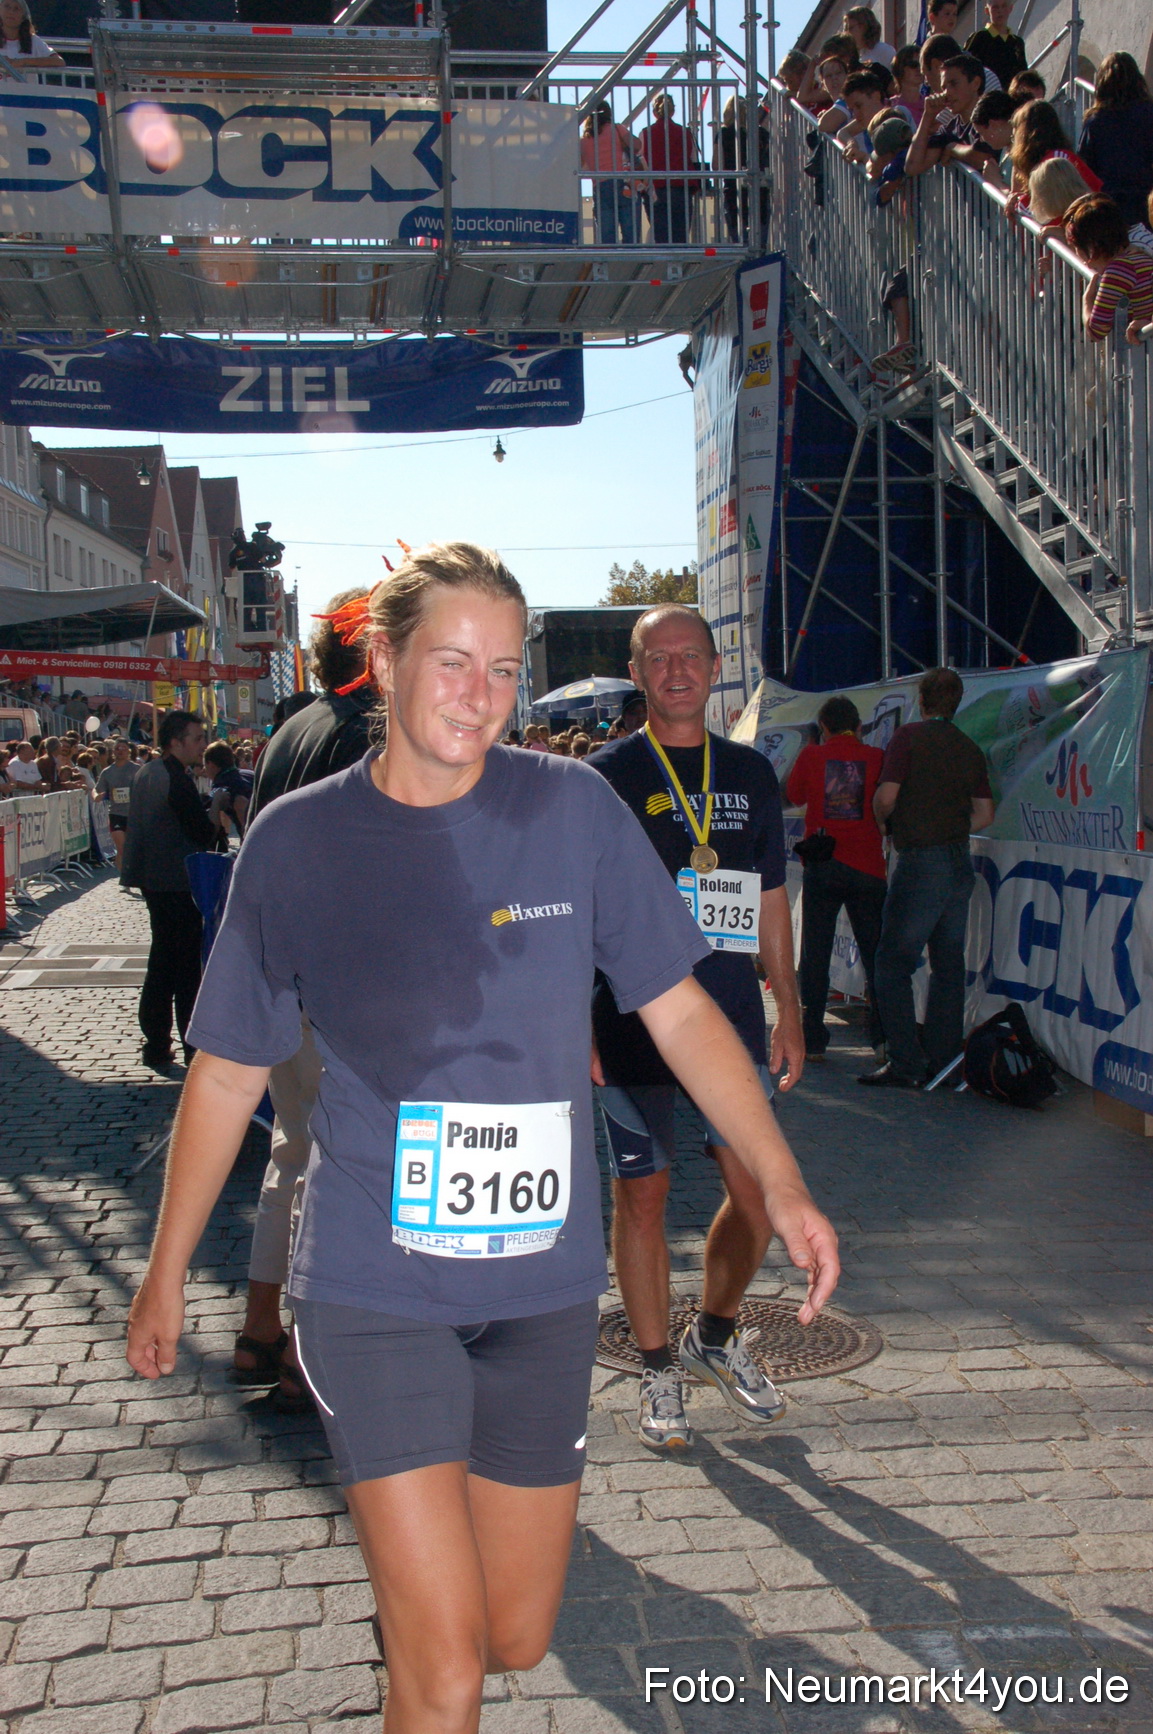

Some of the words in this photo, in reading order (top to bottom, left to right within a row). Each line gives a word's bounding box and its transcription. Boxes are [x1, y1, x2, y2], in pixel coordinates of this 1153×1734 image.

[0, 95, 457, 202] BOCK
[219, 366, 371, 412] ZIEL
[10, 398, 112, 411] www.mizunoeurope.com
[475, 400, 570, 411] www.mizunoeurope.com
[16, 656, 40, 666] Miet-
[42, 658, 49, 667] &
[51, 658, 102, 669] Serviceline:
[103, 661, 127, 670] 09181
[129, 662, 151, 671] 6352
[700, 878, 742, 894] Roland
[508, 902, 573, 922] HÄRTEIS
[702, 904, 755, 930] 3135
[446, 1121, 519, 1151] Panja
[407, 1161, 427, 1185] B
[446, 1168, 560, 1216] 3160
[396, 1229, 465, 1249] BOCK
